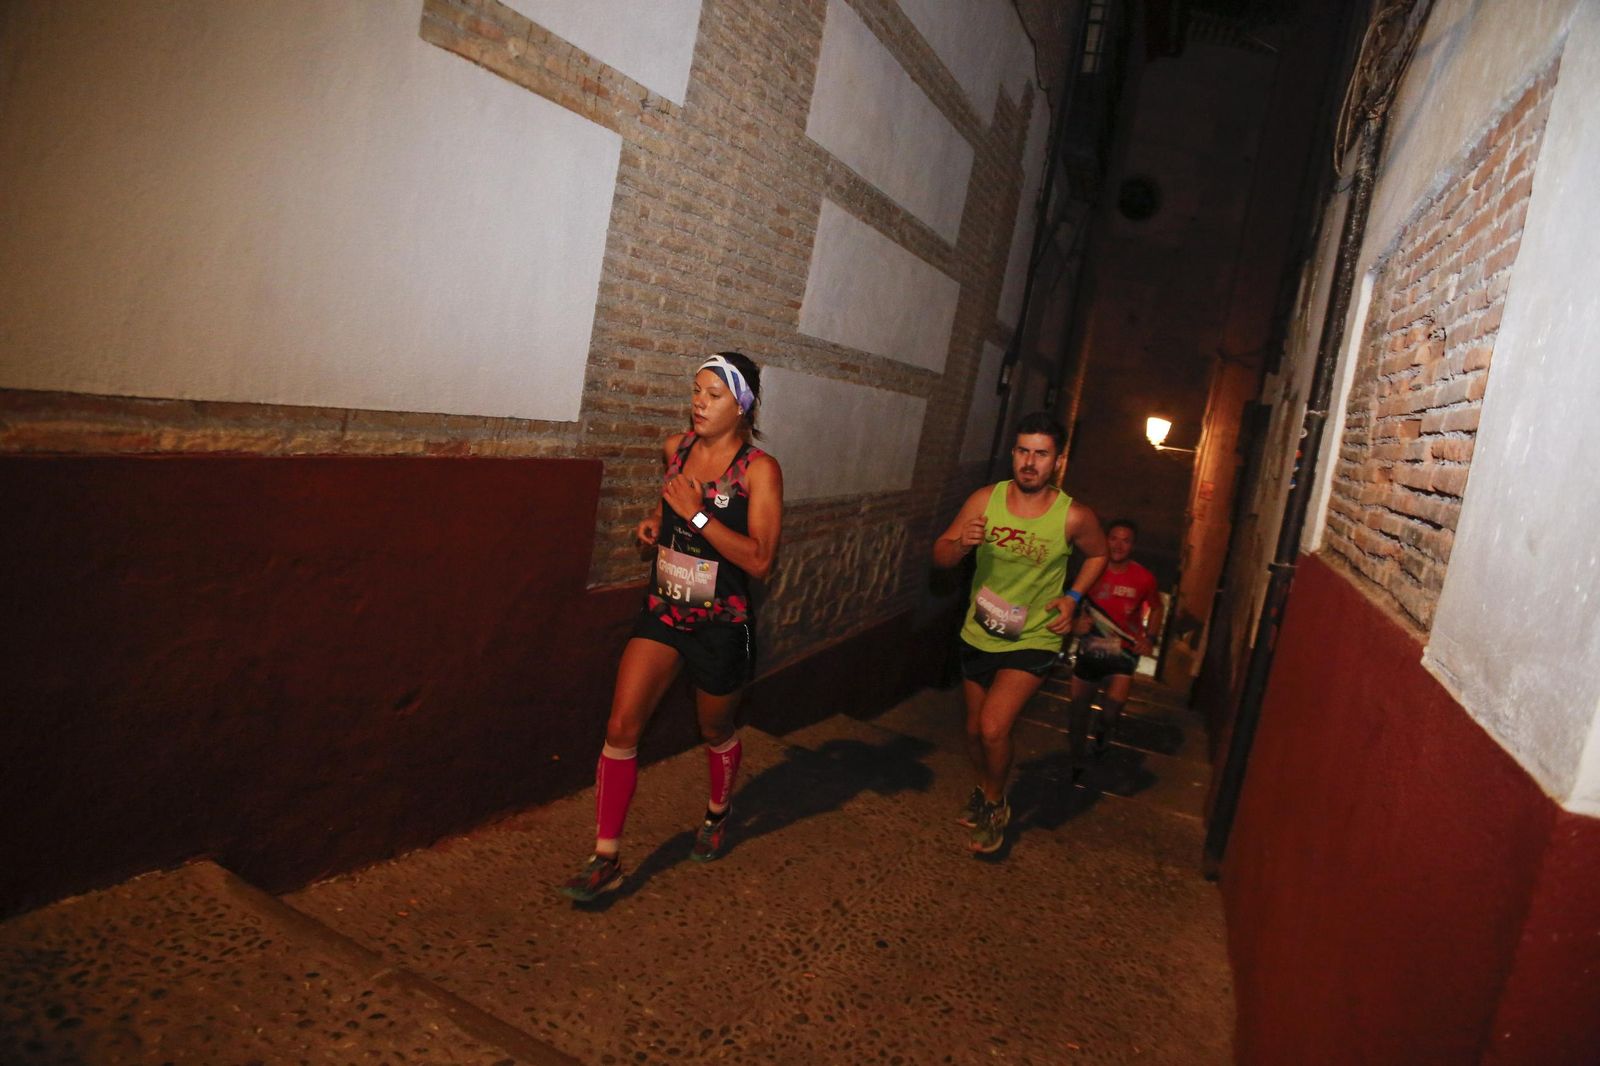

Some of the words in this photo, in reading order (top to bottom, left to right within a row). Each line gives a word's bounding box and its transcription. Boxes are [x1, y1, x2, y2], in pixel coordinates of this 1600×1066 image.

[985, 526, 1026, 547] 525
[666, 580, 691, 602] 351
[984, 614, 1005, 635] 292
